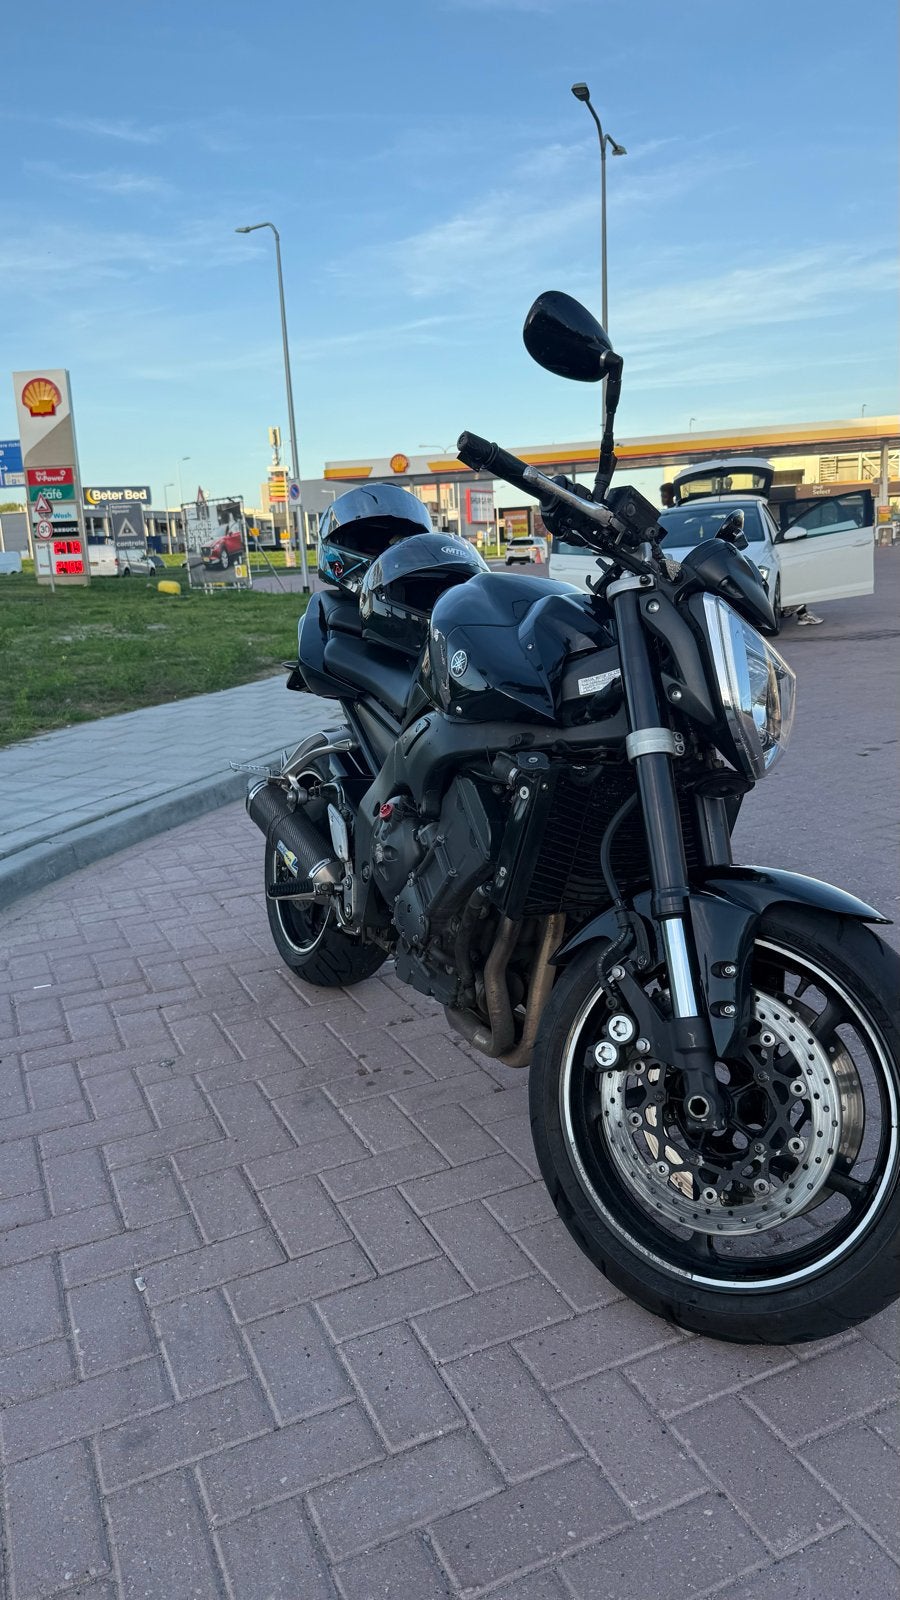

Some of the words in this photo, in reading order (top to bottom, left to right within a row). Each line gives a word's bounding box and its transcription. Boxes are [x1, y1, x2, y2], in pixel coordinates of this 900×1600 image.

[92, 489, 124, 501] Beter
[124, 489, 148, 500] Bed
[40, 524, 49, 534] 30
